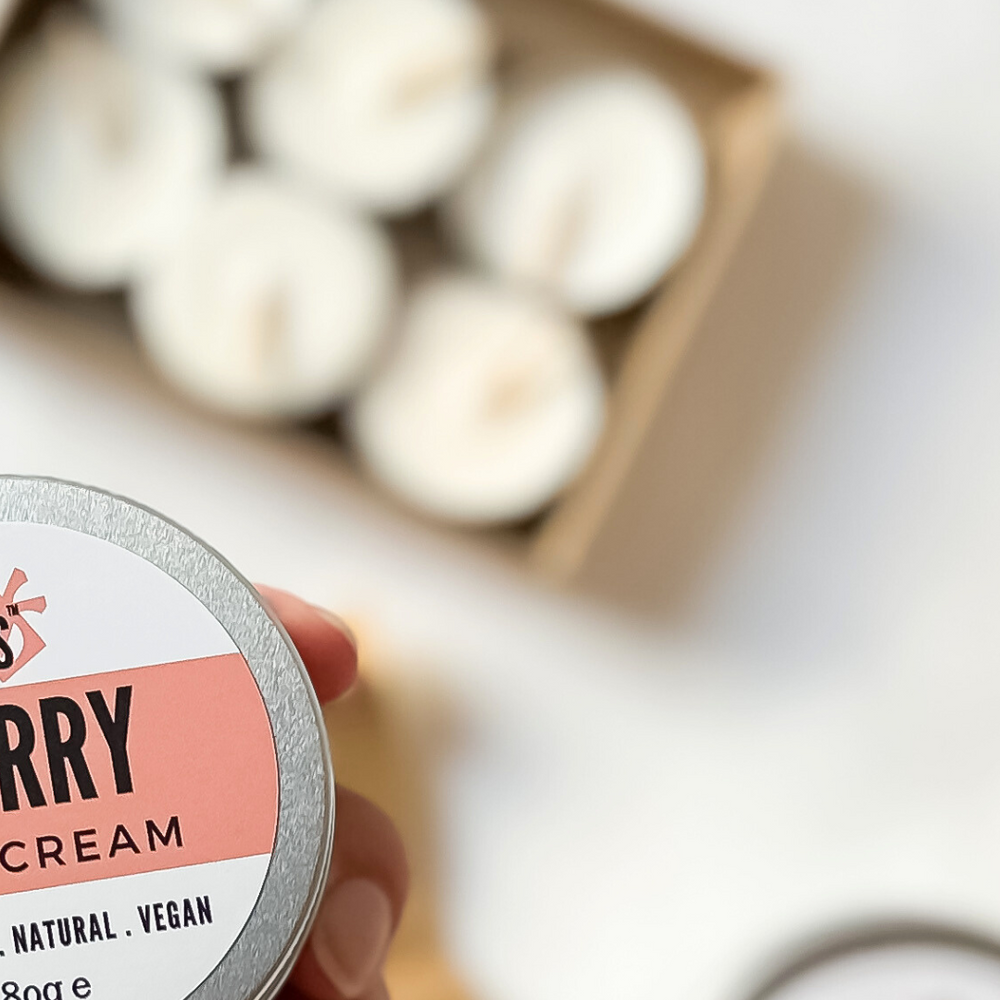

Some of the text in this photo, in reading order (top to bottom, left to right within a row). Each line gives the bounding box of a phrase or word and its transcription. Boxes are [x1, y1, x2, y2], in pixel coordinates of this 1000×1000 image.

[0, 815, 184, 873] CREAM
[12, 911, 117, 954] NATURAL
[137, 896, 213, 934] VEGAN
